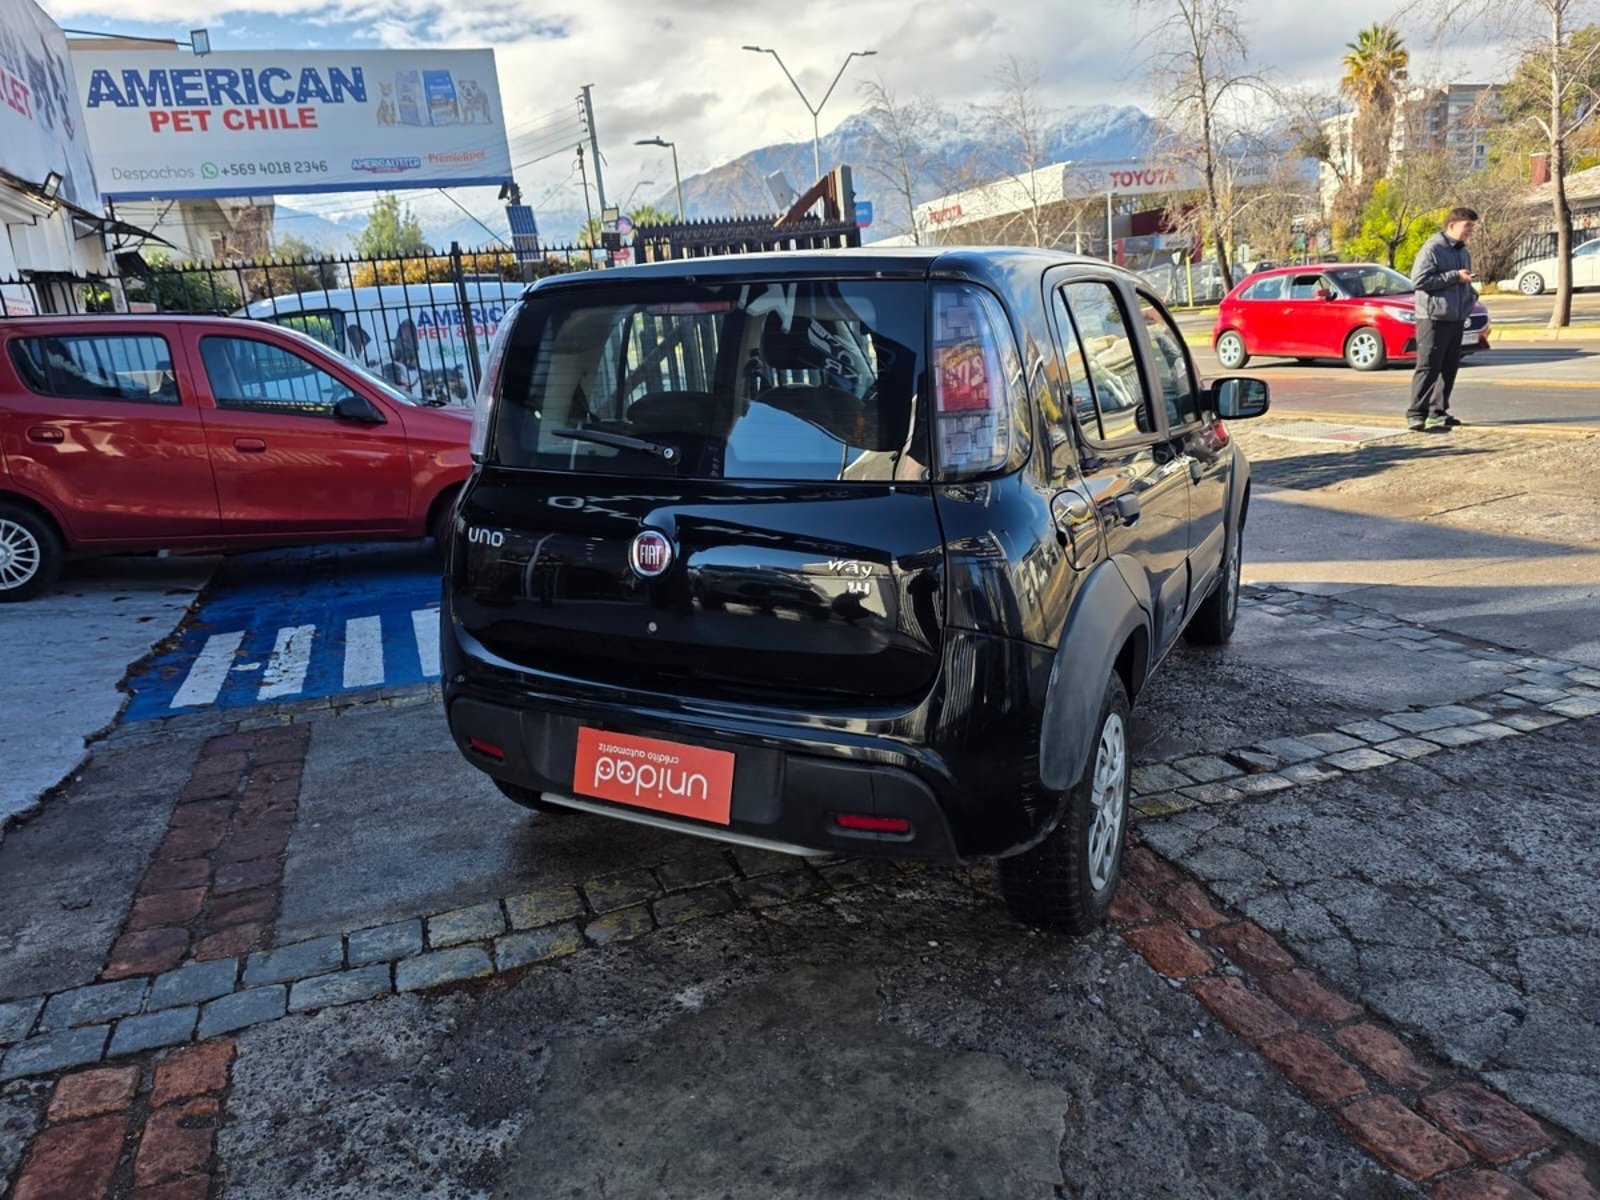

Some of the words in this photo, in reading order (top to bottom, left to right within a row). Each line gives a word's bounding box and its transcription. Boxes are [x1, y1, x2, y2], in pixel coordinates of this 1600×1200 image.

[0, 67, 32, 120] LET
[86, 66, 368, 107] AMERICAN
[149, 109, 211, 132] PET
[222, 107, 318, 131] CHILE
[111, 165, 194, 181] Despachos
[221, 161, 256, 176] +569
[259, 160, 291, 174] 4018
[295, 159, 328, 173] 2346
[1110, 169, 1176, 187] TOYOTA
[928, 204, 963, 223] TOYOTA
[639, 544, 662, 565] FIAT
[598, 742, 646, 758] automotriz
[594, 756, 708, 800] unidad
